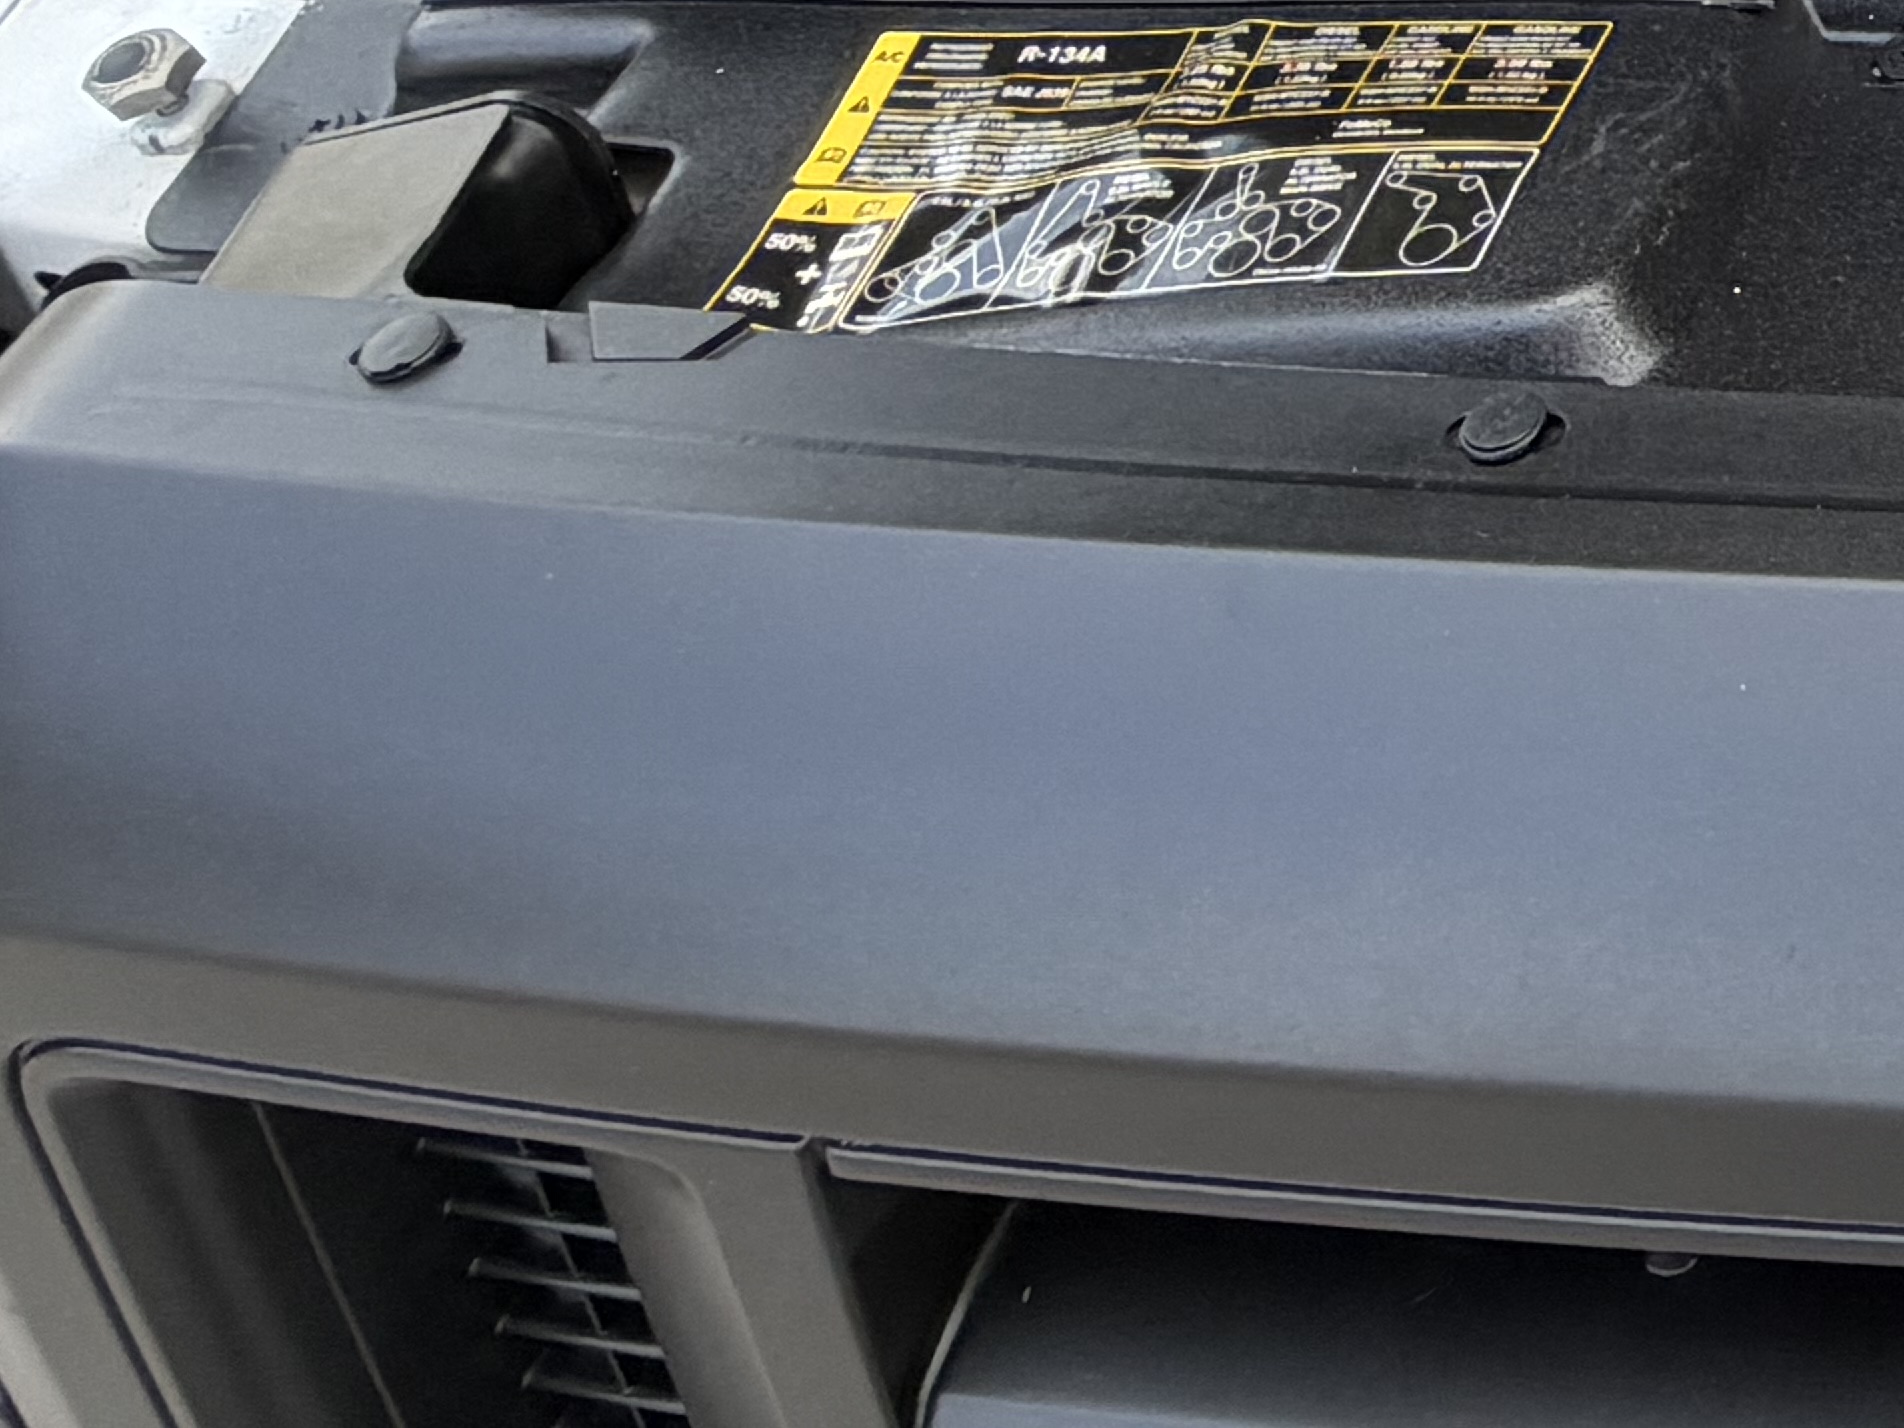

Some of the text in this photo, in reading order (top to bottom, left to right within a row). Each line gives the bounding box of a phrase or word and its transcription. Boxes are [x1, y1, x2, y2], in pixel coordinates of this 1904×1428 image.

[1016, 44, 1108, 65] R-134A
[763, 232, 819, 254] 50%
[724, 284, 783, 311] 50%
